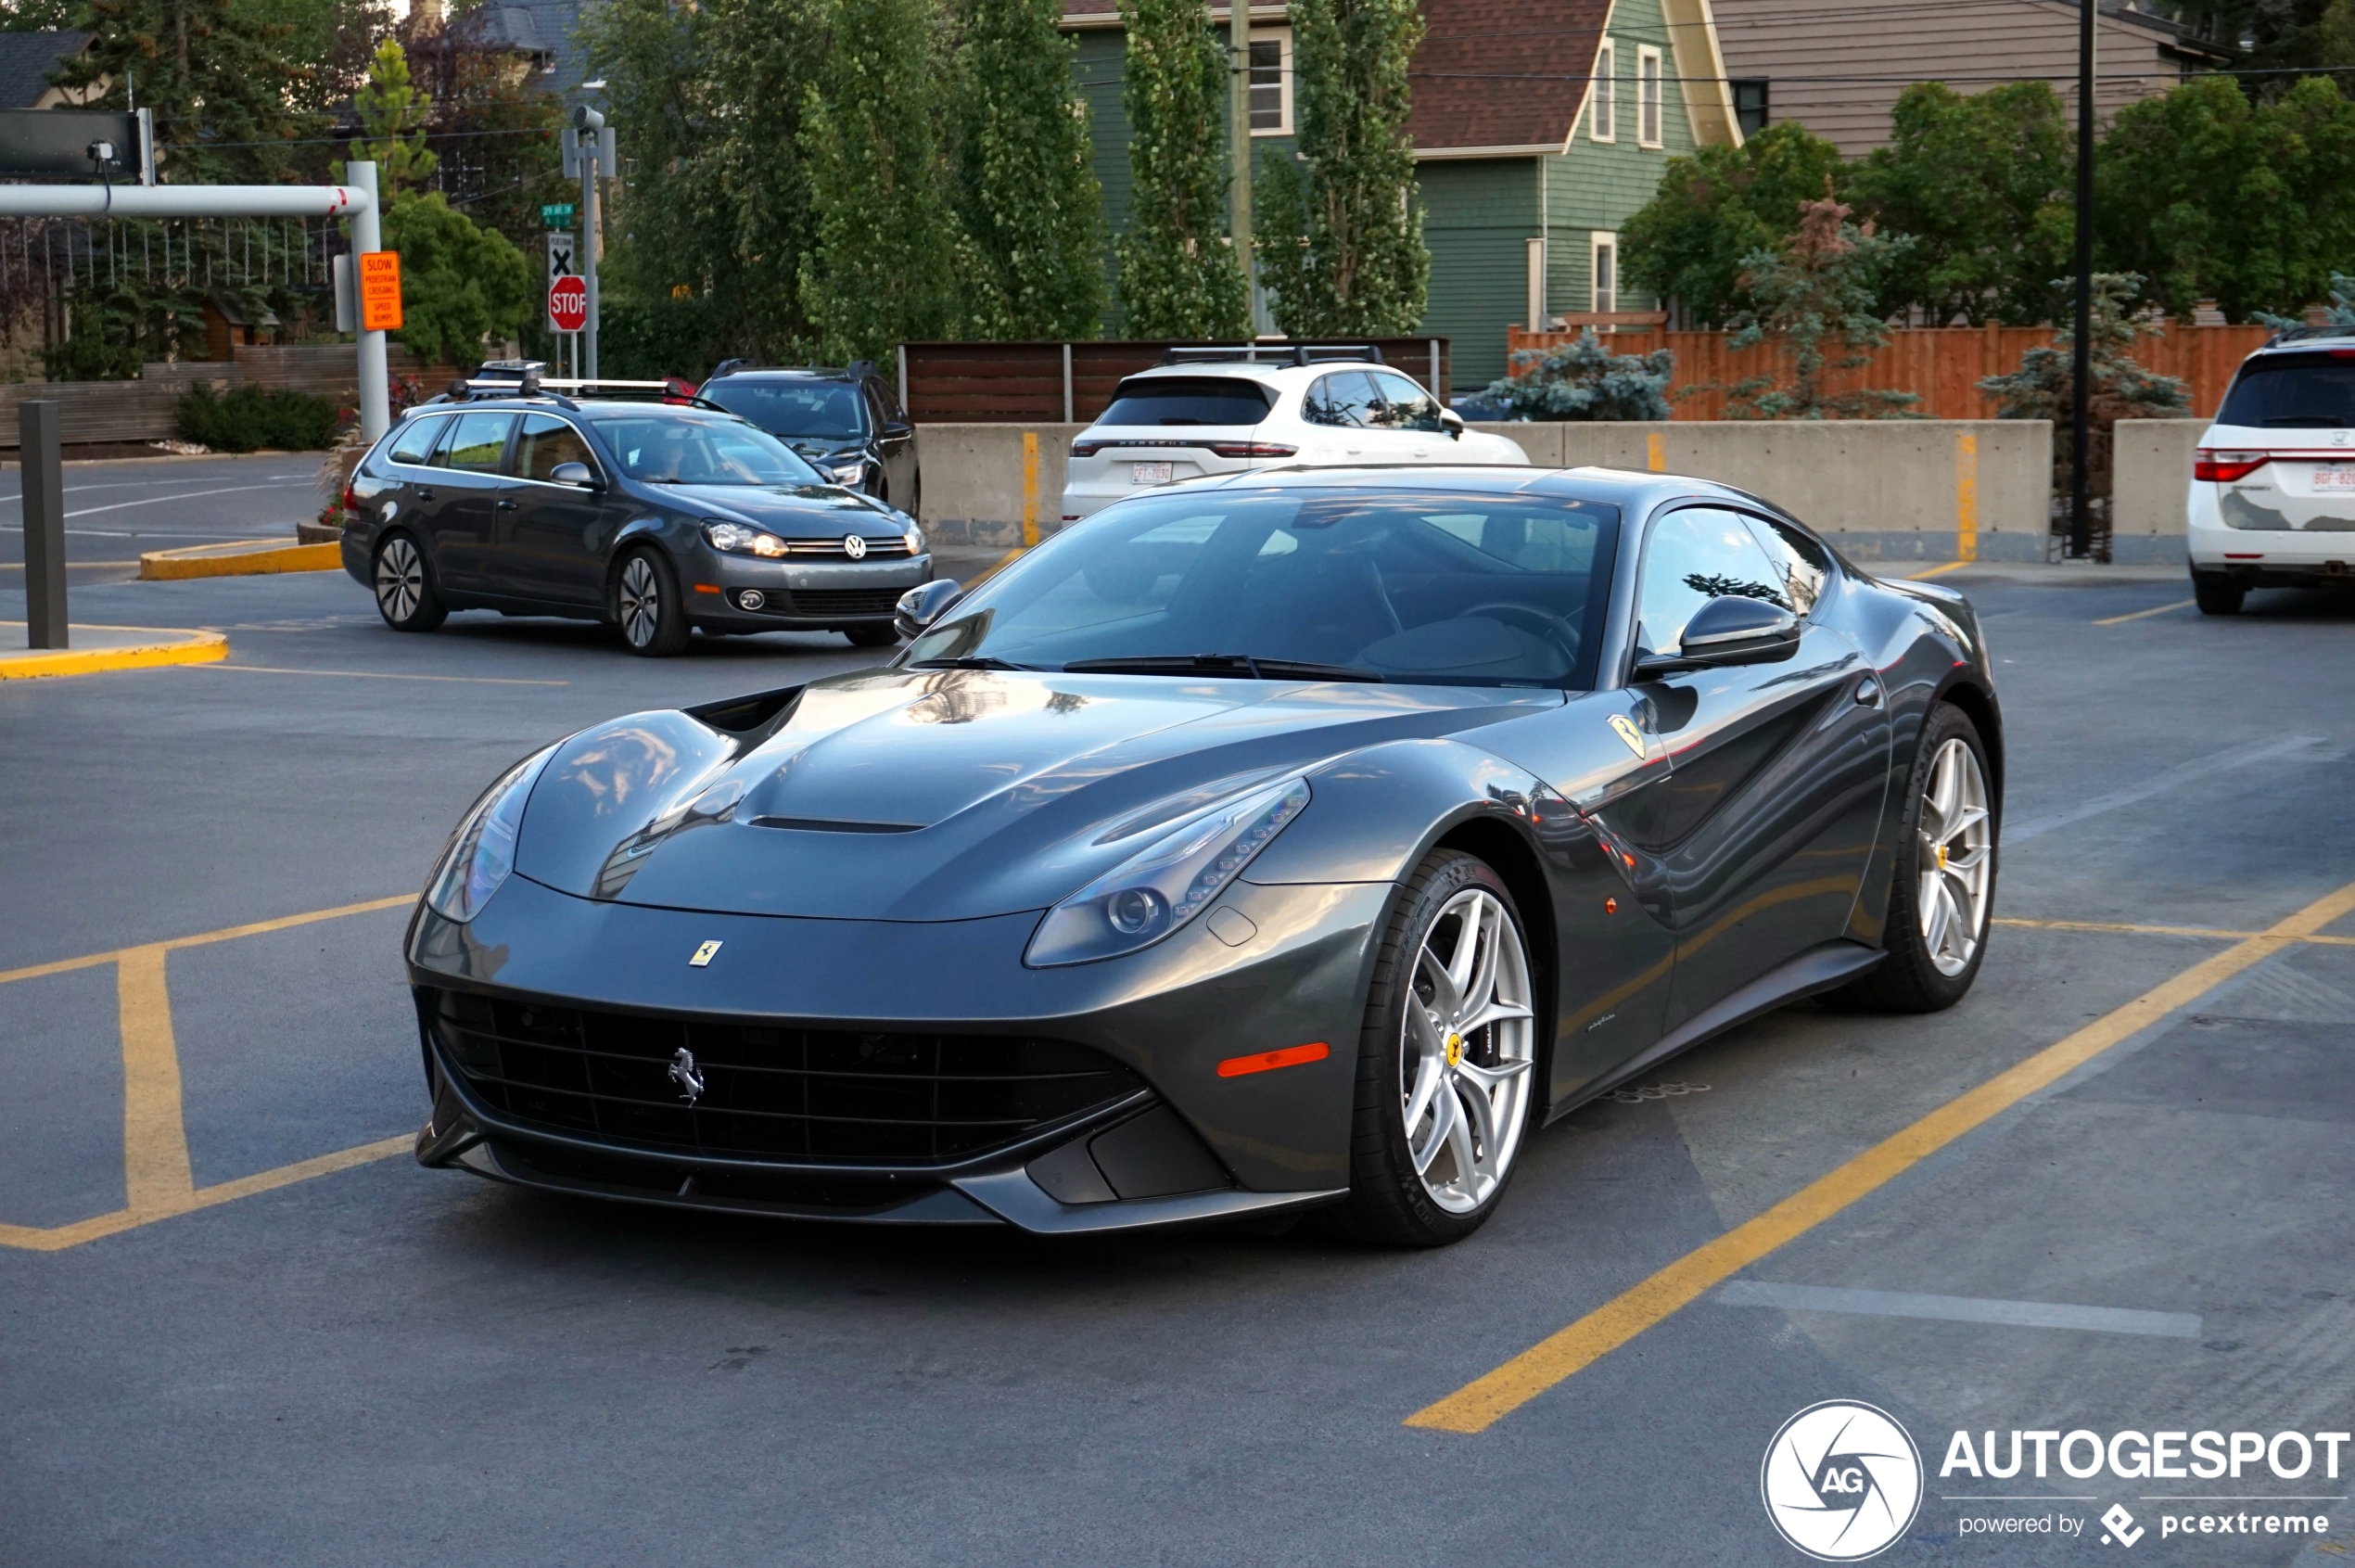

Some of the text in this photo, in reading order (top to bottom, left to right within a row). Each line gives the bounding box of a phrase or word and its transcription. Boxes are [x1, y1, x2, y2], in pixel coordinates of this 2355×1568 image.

[367, 260, 392, 271] SLOW
[365, 274, 397, 284] PEDESTRIAN
[368, 286, 395, 295] CROSSING
[374, 302, 391, 312] SPEED
[374, 313, 393, 323] BUMPS
